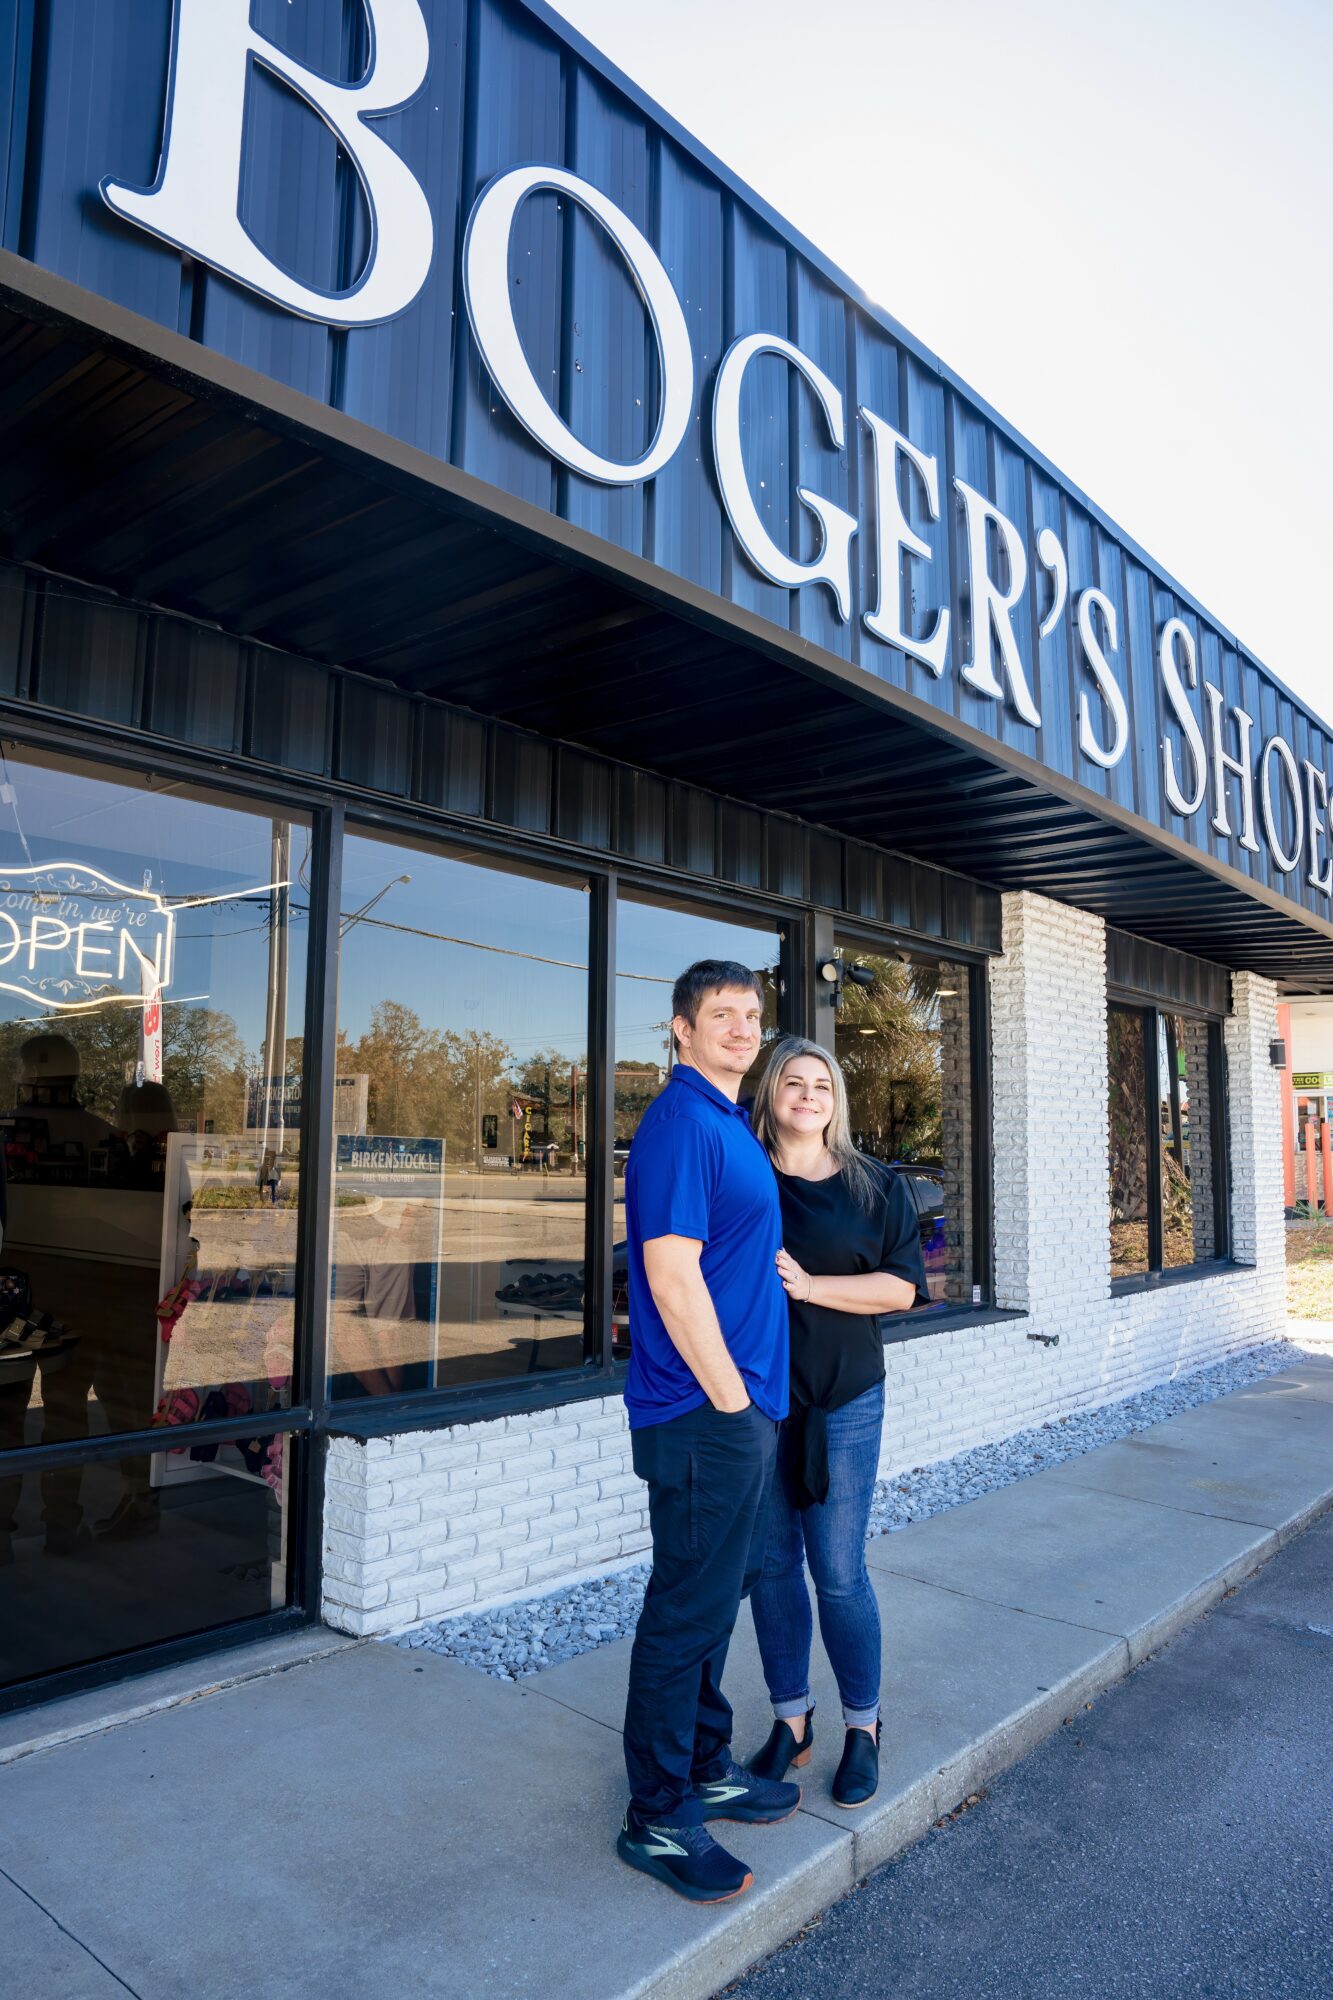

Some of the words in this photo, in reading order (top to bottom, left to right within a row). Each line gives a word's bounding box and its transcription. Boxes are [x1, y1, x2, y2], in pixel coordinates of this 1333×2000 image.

[99, 0, 1129, 769] BOGER'S
[1159, 617, 1333, 898] SHOE
[0, 893, 51, 914] ome
[58, 896, 84, 919] in,
[90, 903, 147, 926] we're
[351, 1151, 426, 1169] BIRKENSTOCK
